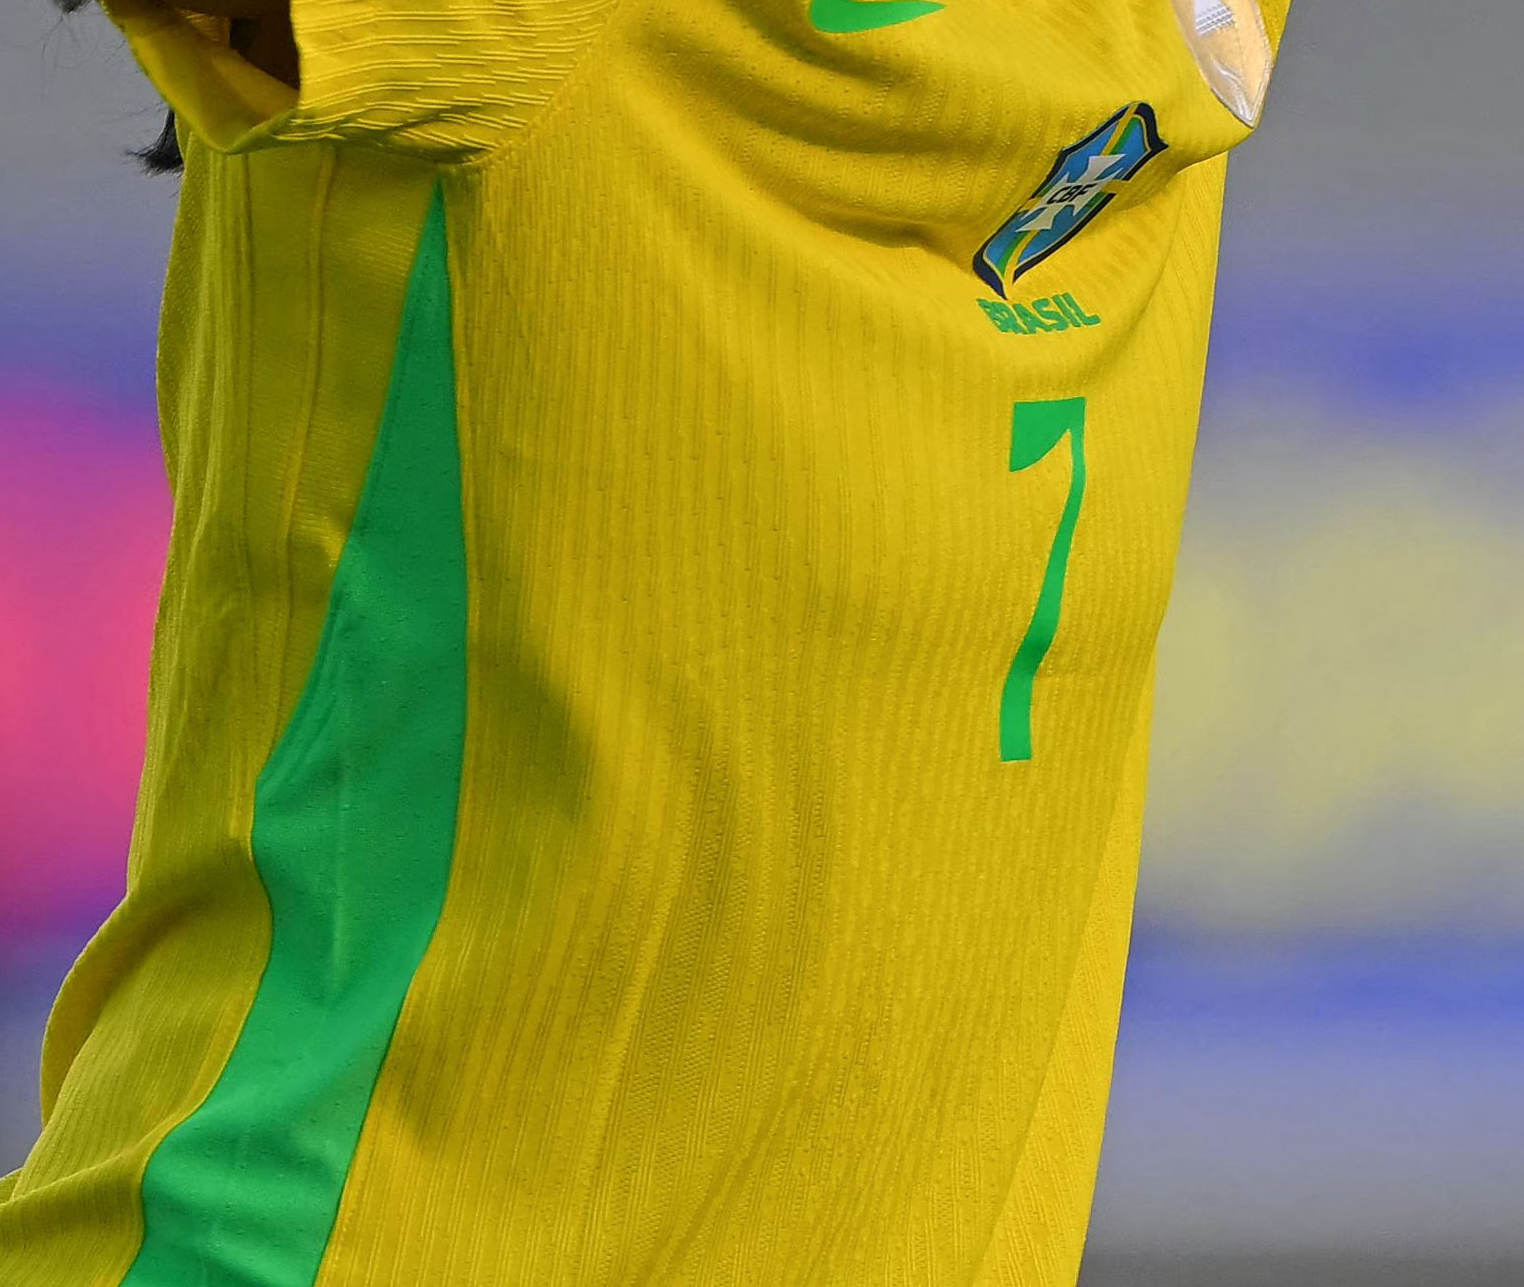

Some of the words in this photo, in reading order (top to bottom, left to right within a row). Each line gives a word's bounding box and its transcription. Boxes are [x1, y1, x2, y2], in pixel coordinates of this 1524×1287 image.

[1046, 182, 1095, 205] CBF
[975, 292, 1101, 335] BRASIL
[999, 396, 1086, 762] 7
